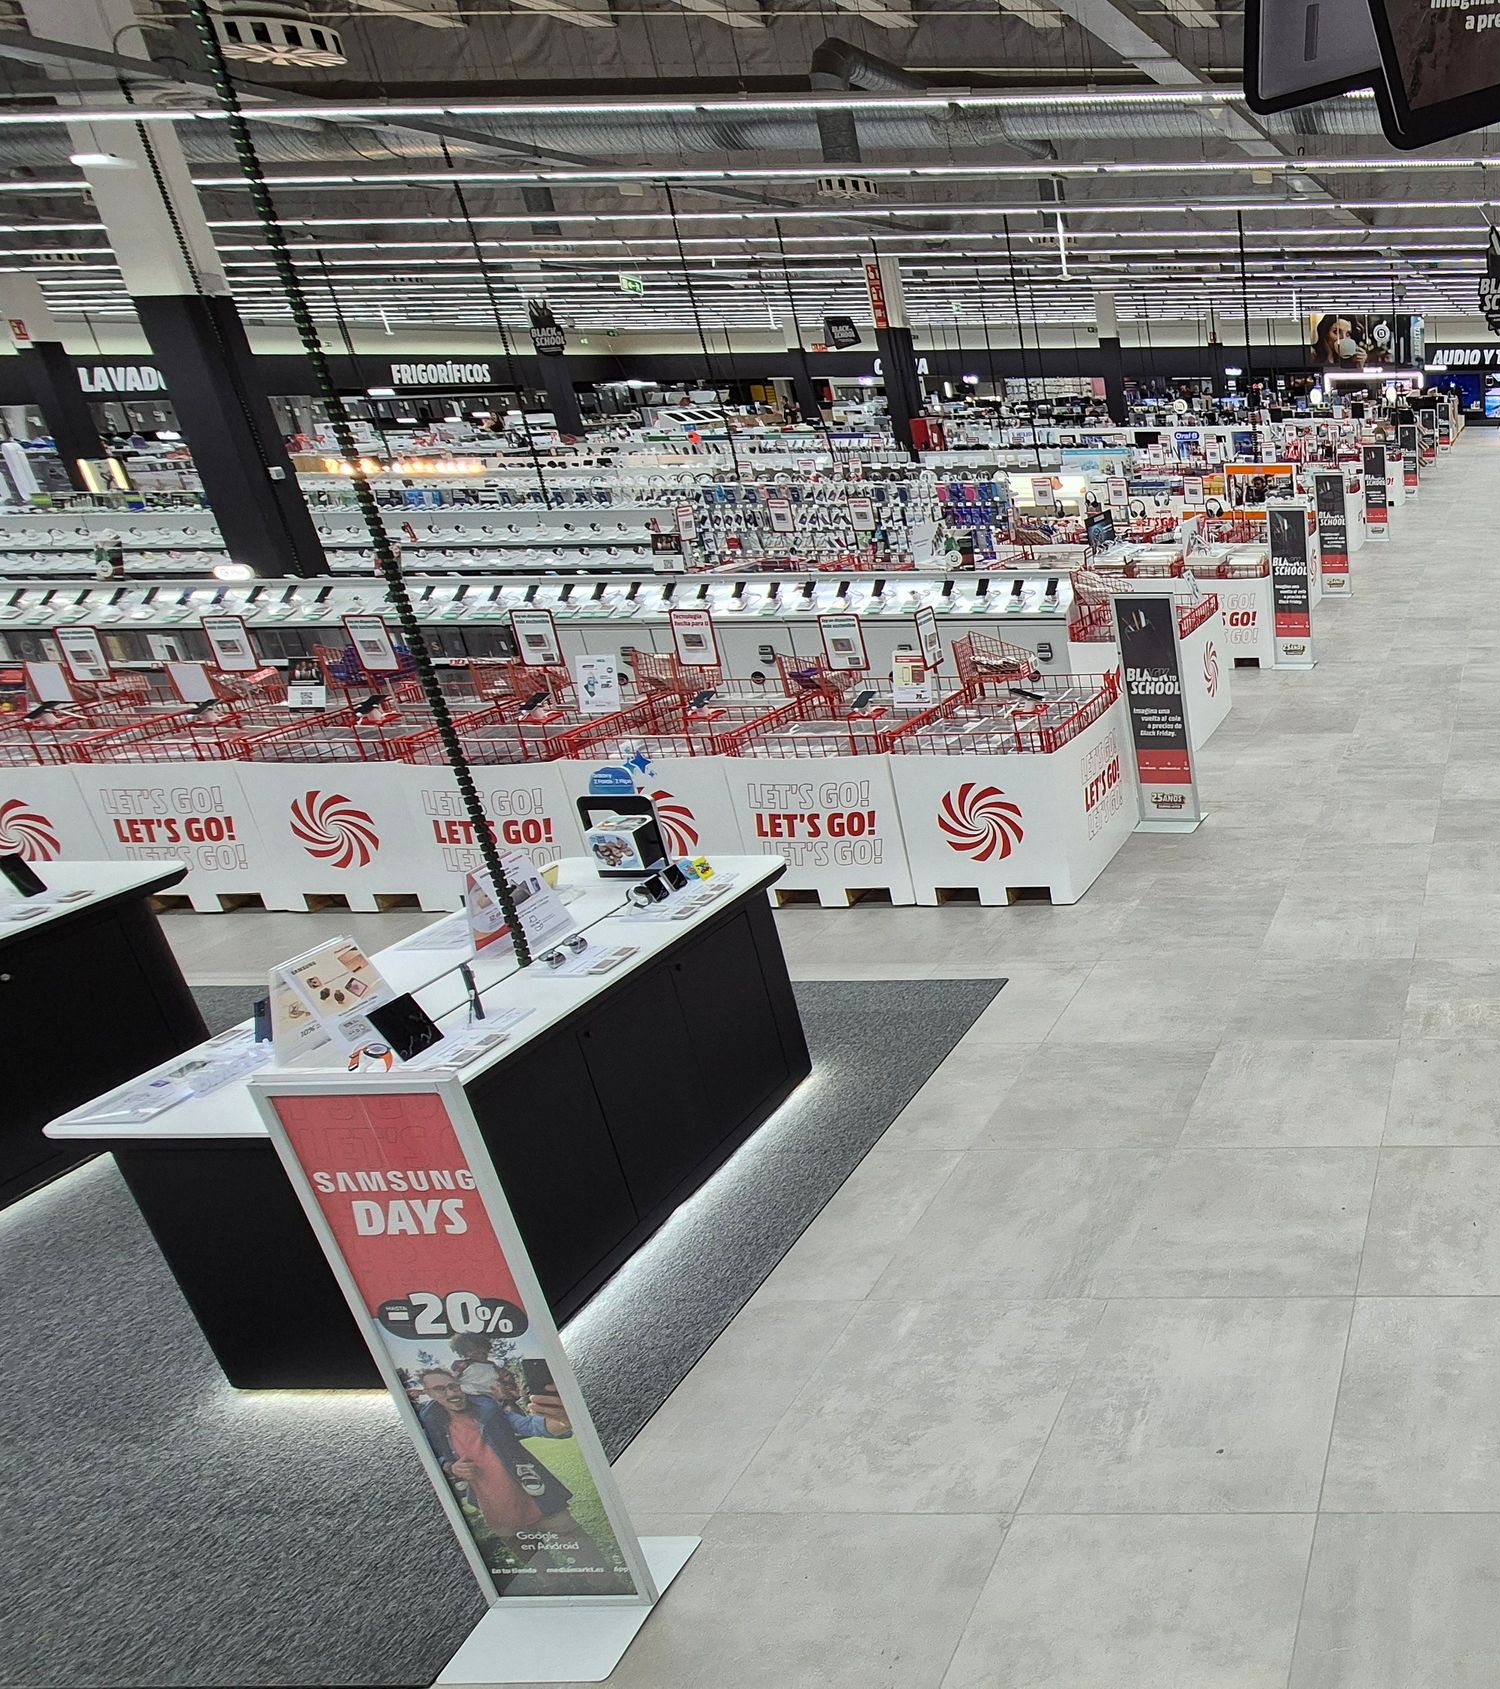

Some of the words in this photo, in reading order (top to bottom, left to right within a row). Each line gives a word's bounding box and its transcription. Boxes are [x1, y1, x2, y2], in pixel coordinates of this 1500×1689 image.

[1464, 14, 1475, 30] a
[531, 327, 558, 339] BLACK
[535, 332, 566, 348] SCHOOL
[1432, 349, 1481, 365] AUDIO
[1483, 349, 1497, 365] Y
[77, 366, 169, 392] LAVAD
[391, 360, 492, 385] FRIGORÍFICOS
[1320, 517, 1346, 526] SCHOOL
[1275, 565, 1308, 576] SCHOOL
[1230, 611, 1258, 627] GO!
[1126, 667, 1171, 683] BLACK
[1130, 681, 1182, 696] SCHOOL
[1133, 707, 1157, 716] Imagina
[1140, 715, 1160, 723] vuelta
[1140, 730, 1157, 738] Black
[1084, 769, 1107, 813] LET'S
[1105, 754, 1121, 790] GO!
[99, 787, 166, 816] LET'S
[170, 785, 225, 814] GO!
[491, 787, 545, 816] GO!
[747, 783, 815, 810] LET'S
[819, 780, 871, 808] GO!
[113, 818, 186, 843] LET'S
[184, 815, 237, 842] GO!
[502, 817, 554, 843] GO!
[755, 812, 822, 839] LET'S
[826, 810, 877, 838] GO!
[189, 844, 249, 871] GO!
[833, 837, 884, 866] GO!
[312, 1169, 477, 1193] SAMSUNG
[351, 1198, 469, 1237] DAYS
[386, 1291, 514, 1335] -20%
[516, 1530, 559, 1543] Google
[521, 1543, 536, 1551] en
[537, 1541, 580, 1551] Android
